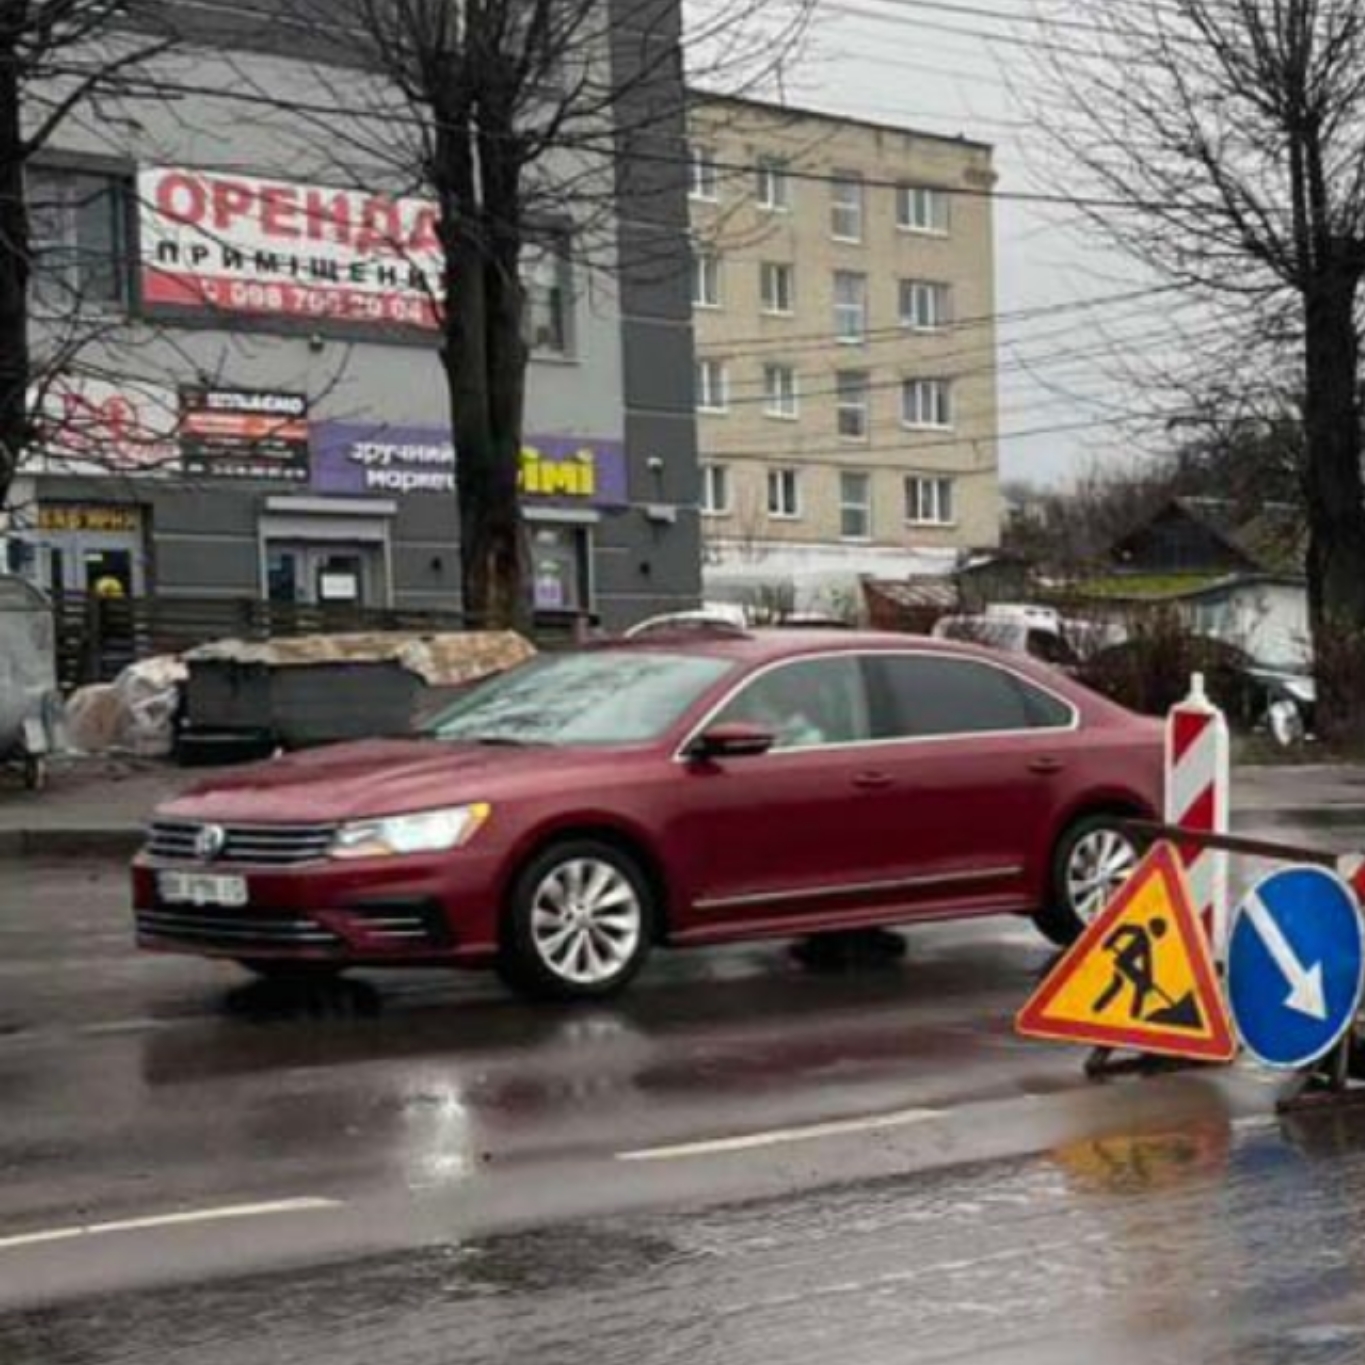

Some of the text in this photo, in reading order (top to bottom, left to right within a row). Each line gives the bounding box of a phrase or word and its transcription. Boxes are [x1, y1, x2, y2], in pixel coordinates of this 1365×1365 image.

[156, 171, 442, 254] ОРЕНДА
[156, 239, 446, 293] ПРИМІЩЕНН
[518, 446, 595, 495] імі
